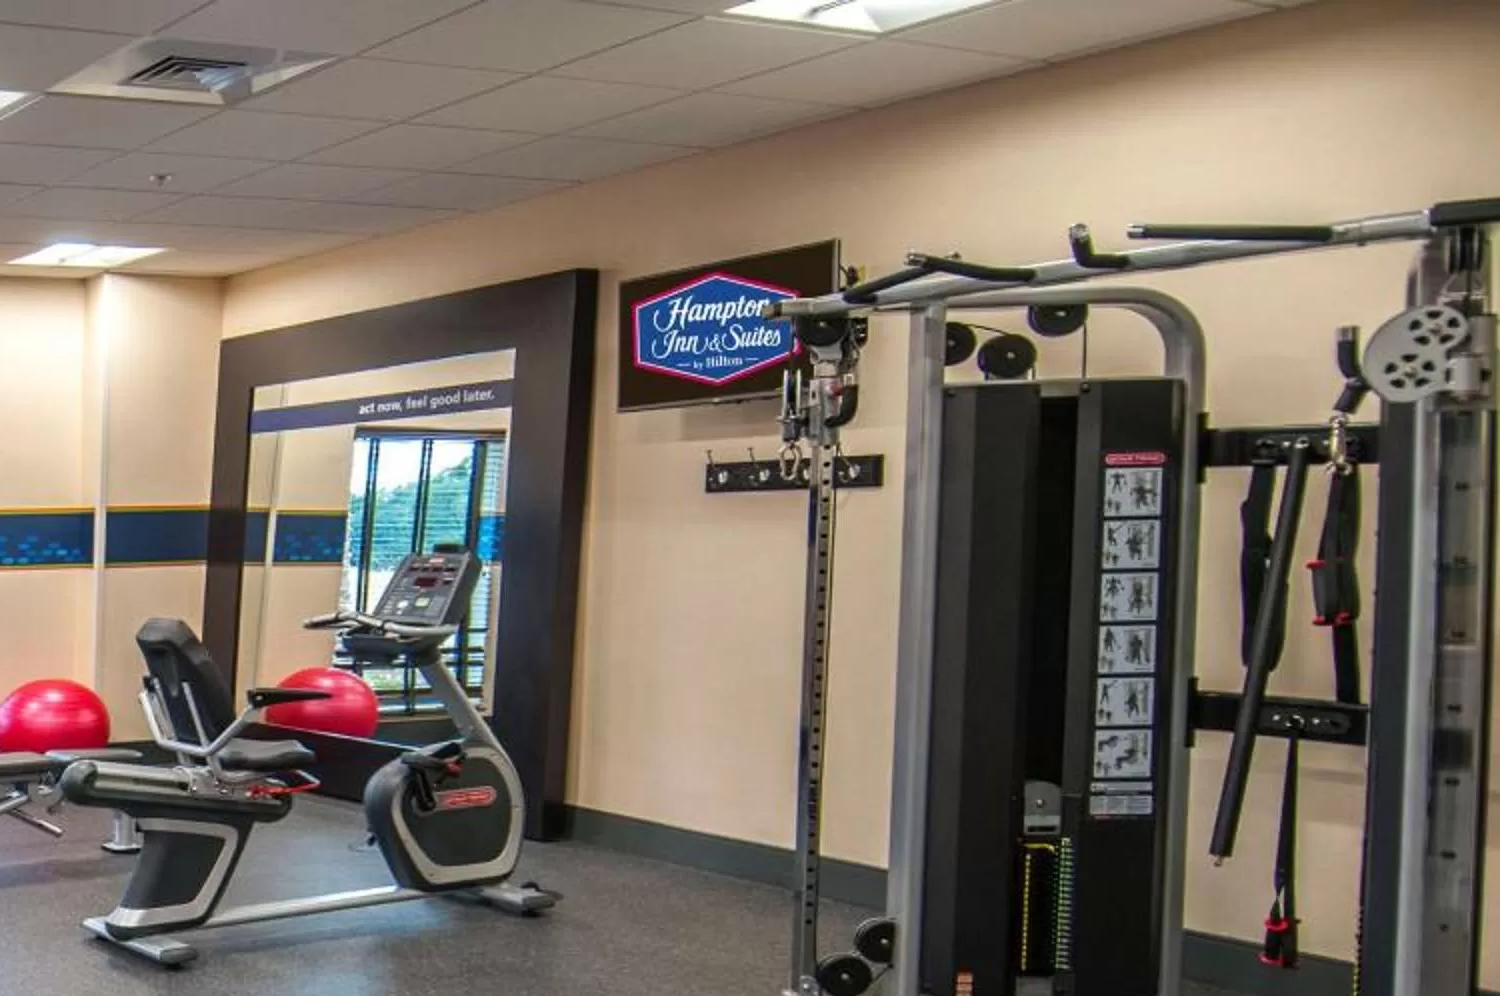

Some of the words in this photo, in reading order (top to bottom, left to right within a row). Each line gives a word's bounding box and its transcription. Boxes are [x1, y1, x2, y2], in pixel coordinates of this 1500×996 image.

[651, 327, 709, 359] Inn
[721, 323, 781, 351] Suites
[429, 390, 461, 409] good
